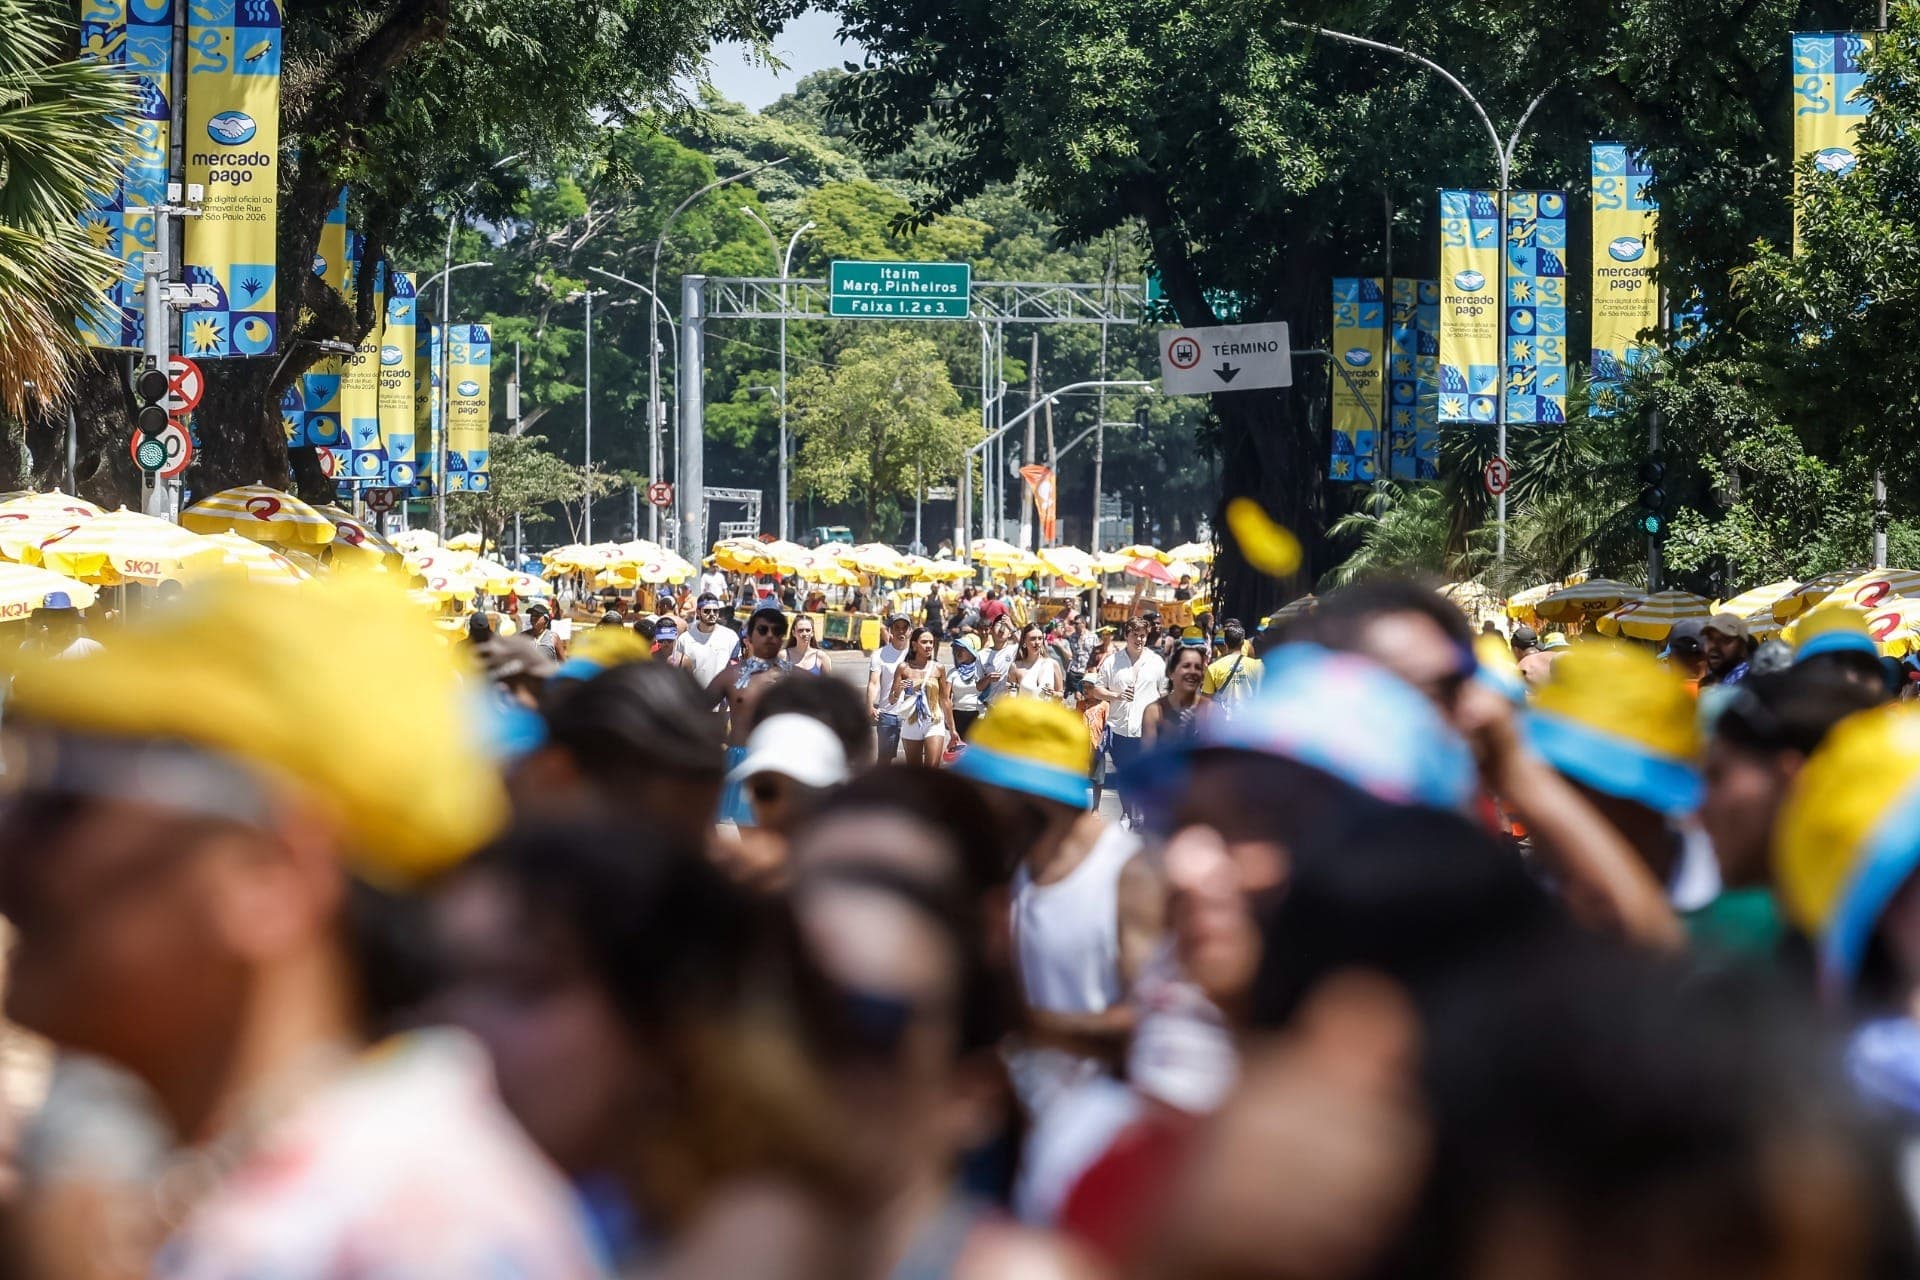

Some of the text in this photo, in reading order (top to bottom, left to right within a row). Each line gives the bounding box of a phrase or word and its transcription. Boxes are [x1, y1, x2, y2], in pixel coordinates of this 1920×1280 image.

[192, 151, 270, 167] mercado
[209, 170, 253, 186] pago
[214, 195, 238, 204] digital
[238, 195, 261, 203] oficial
[262, 196, 273, 204] do
[199, 203, 262, 212] Carnaval de Rua
[222, 212, 244, 221] Paulo
[245, 212, 267, 221] 2026
[880, 267, 920, 279] Itaim
[1597, 265, 1648, 277] mercad
[843, 279, 957, 294] Marg. Pinheiros
[1610, 279, 1642, 291] pago
[1444, 295, 1494, 305] mercado
[851, 300, 893, 312] Faixa
[923, 303, 932, 313] e
[935, 302, 947, 313] 3.
[1456, 306, 1484, 317] pago
[1212, 341, 1278, 356] TÉRMINO
[381, 369, 411, 378] rcado
[458, 407, 479, 415] pago
[164, 434, 181, 459] 0
[124, 559, 161, 575] SKOL
